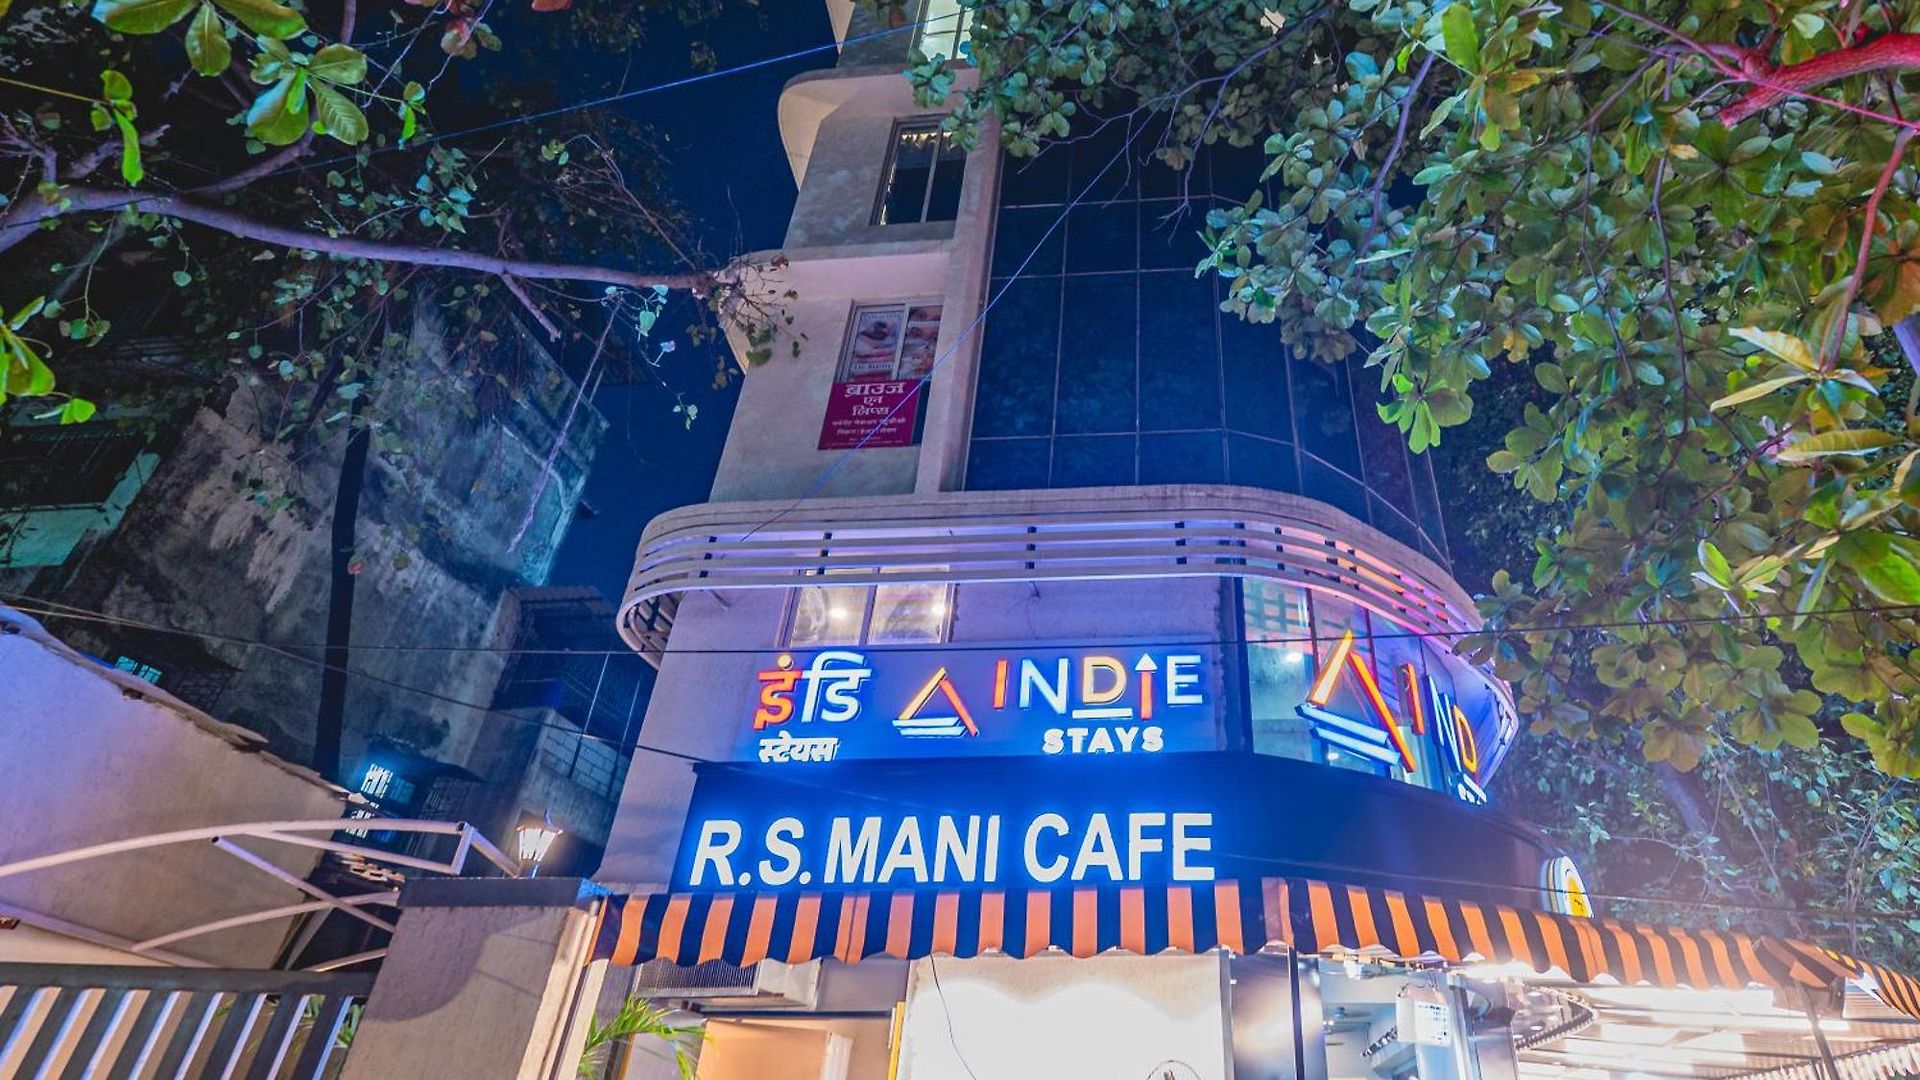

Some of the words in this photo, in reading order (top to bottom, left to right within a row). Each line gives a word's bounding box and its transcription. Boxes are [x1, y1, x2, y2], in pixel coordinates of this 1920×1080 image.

[754, 651, 872, 729] इंडि
[993, 653, 1204, 720] INDIE
[1042, 726, 1164, 755] STAYS
[1023, 812, 1215, 884] CAFE
